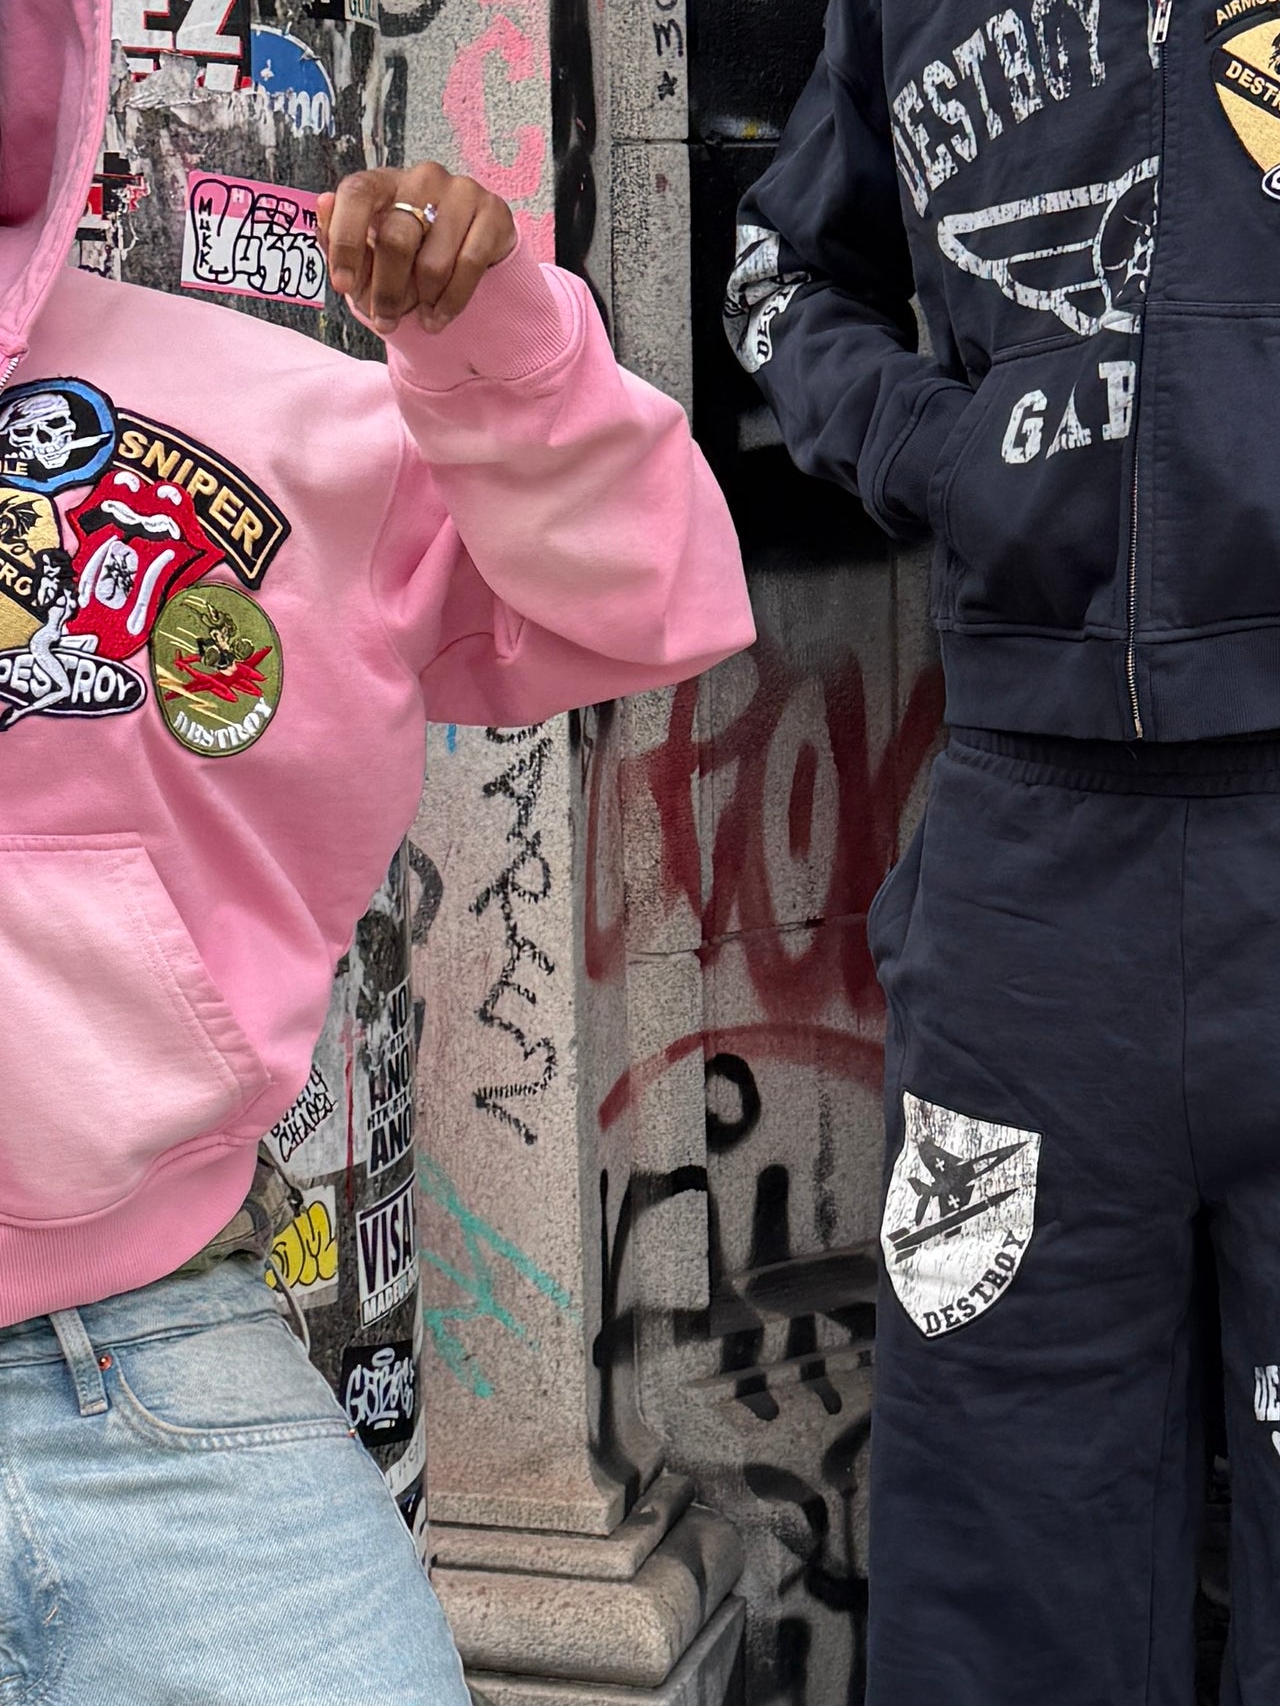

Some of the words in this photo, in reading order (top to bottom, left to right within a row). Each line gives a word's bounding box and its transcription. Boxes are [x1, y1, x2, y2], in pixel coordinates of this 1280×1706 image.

[118, 430, 264, 558] SNIPER
[174, 697, 272, 749] DESTROY
[922, 1230, 1027, 1335] DESTROY
